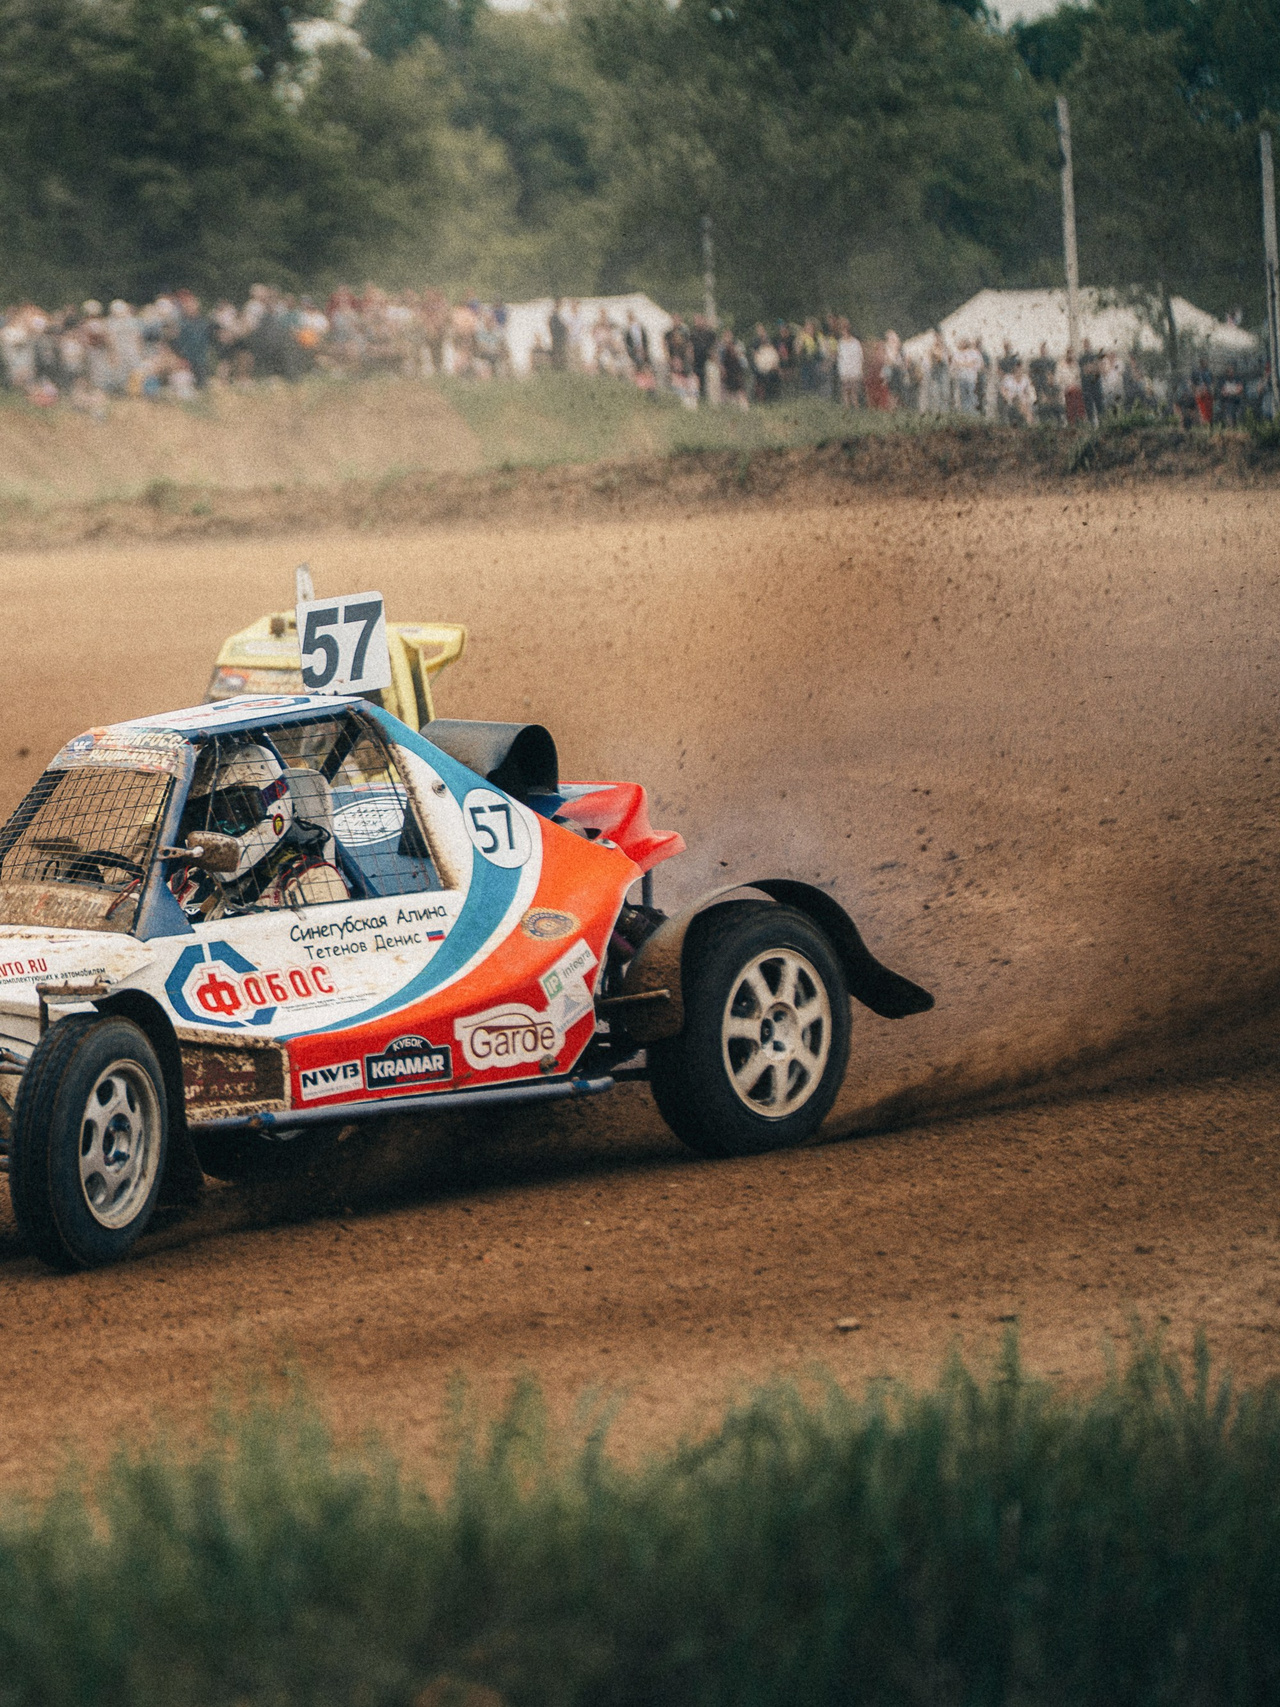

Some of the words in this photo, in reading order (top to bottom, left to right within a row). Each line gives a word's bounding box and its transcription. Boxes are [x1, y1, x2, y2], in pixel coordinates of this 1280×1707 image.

[302, 599, 383, 689] 57
[468, 803, 515, 853] 57
[289, 914, 388, 943] Синегубская
[396, 904, 448, 925] Алина
[304, 941, 368, 961] Тетенов
[375, 931, 422, 954] Денис
[0, 973, 54, 986] комплектующих
[196, 965, 336, 1016] ФОБОС
[545, 975, 560, 995] IP
[393, 1037, 424, 1052] КУБОК
[470, 1020, 556, 1060] Garde
[301, 1062, 361, 1088] NWB
[371, 1053, 445, 1079] KRAMAR
